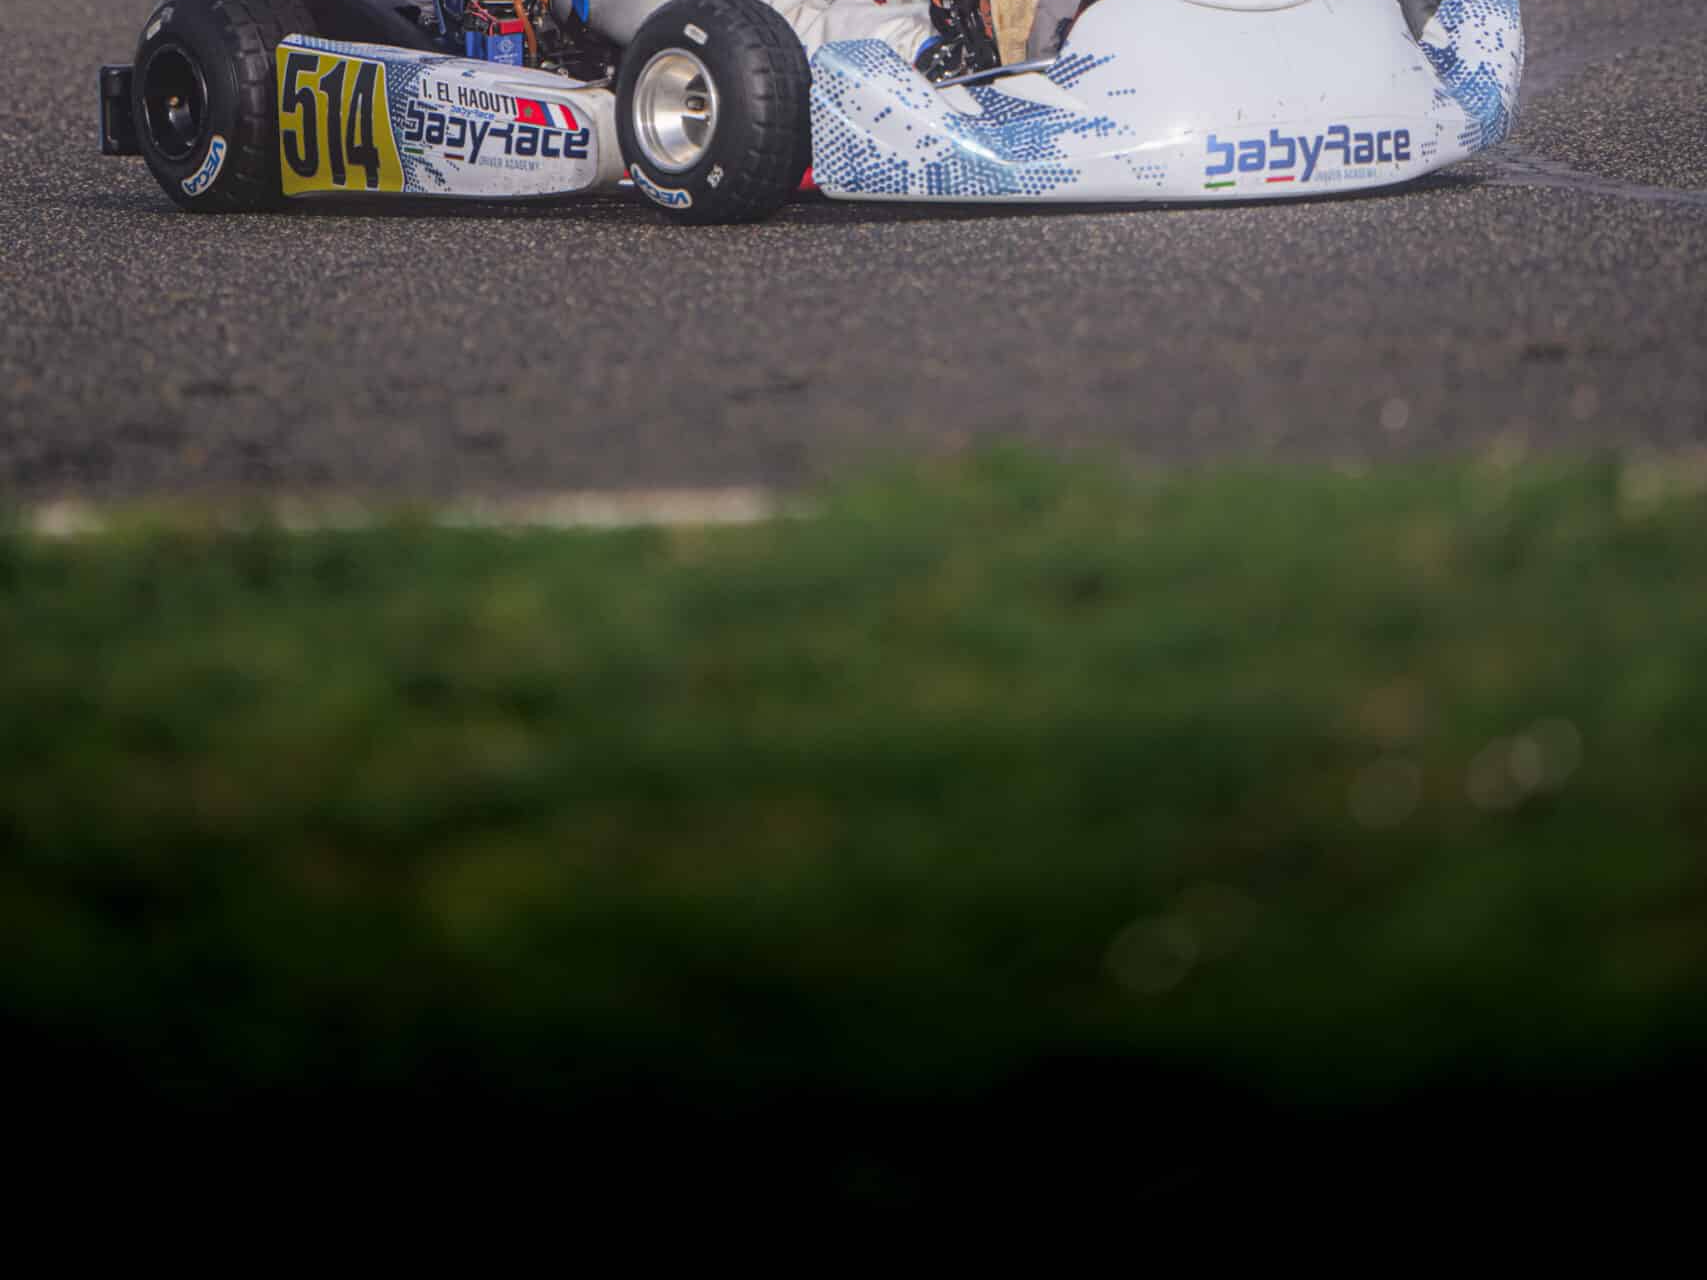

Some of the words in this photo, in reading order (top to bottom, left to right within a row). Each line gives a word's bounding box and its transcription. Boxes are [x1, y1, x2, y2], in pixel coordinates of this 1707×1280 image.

[282, 53, 380, 189] 514
[423, 79, 433, 99] I.
[437, 81, 453, 104] EL
[458, 86, 518, 116] HAOUTI
[184, 141, 225, 193] VEGA
[1204, 124, 1411, 183] babyRace
